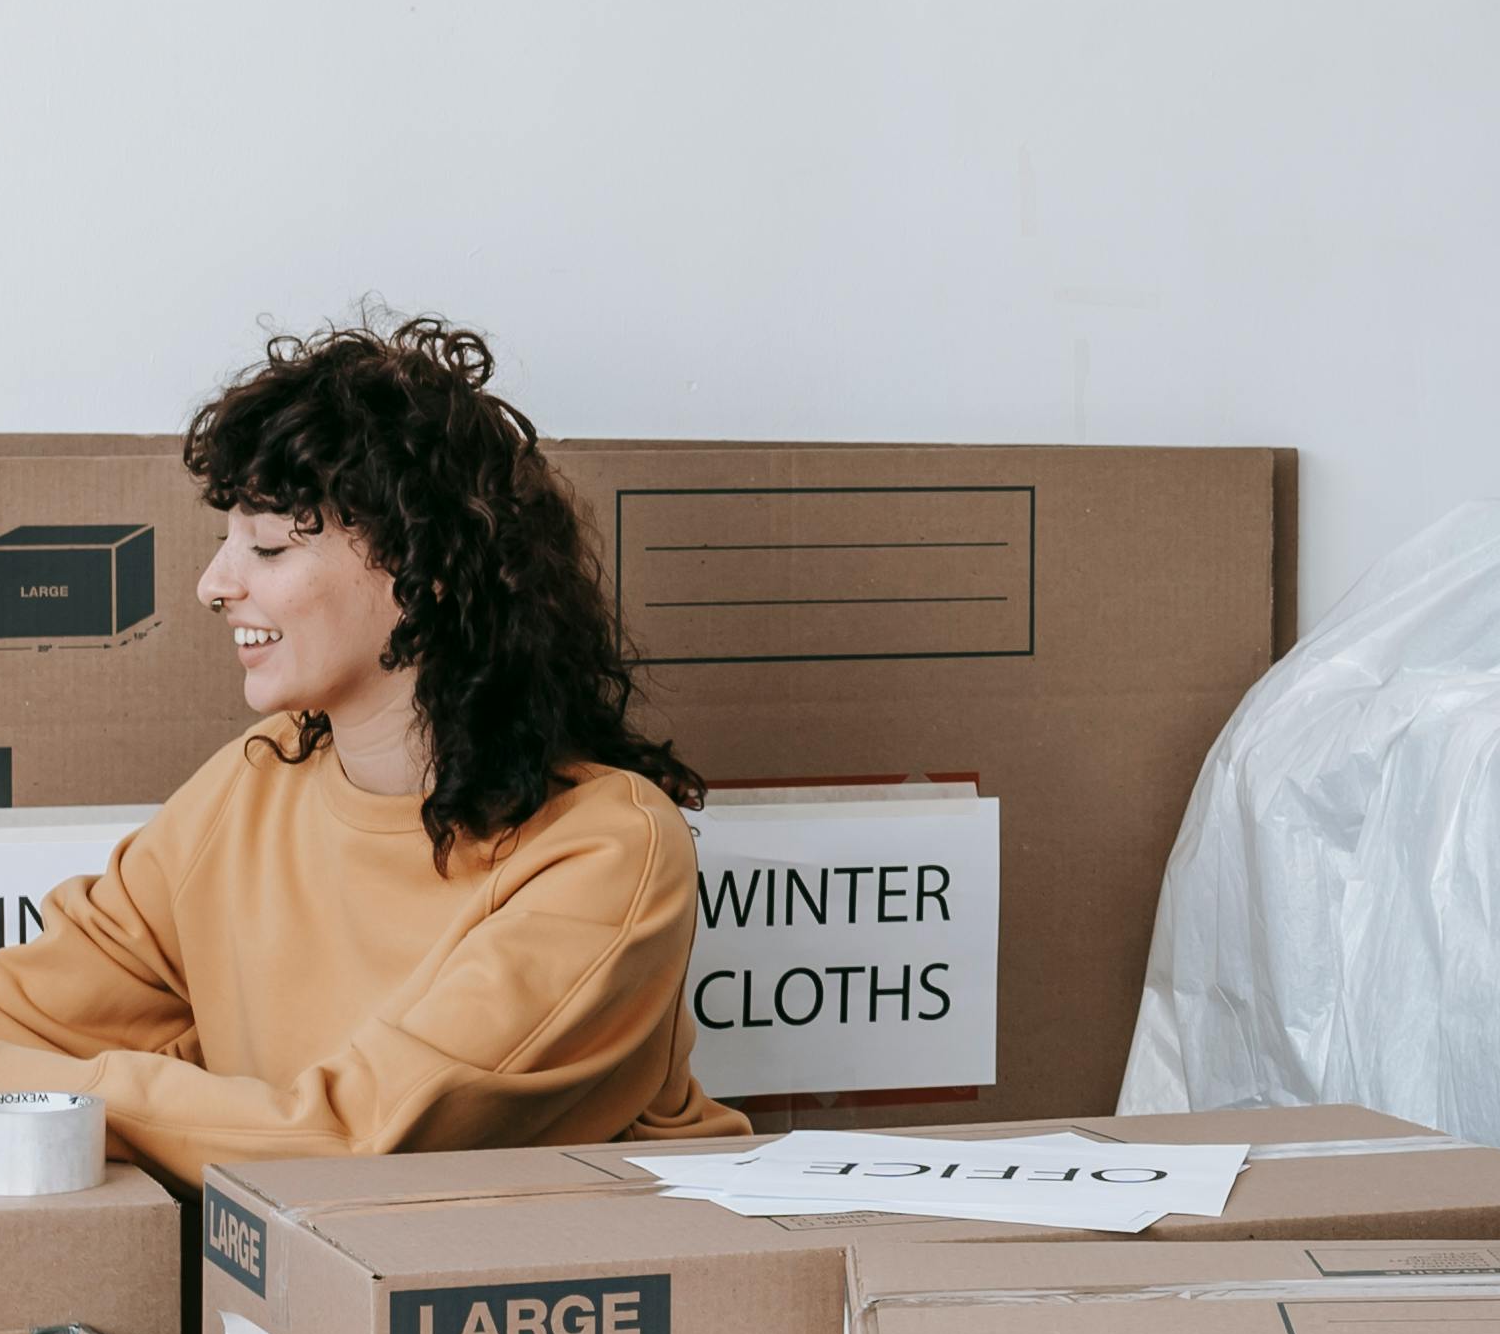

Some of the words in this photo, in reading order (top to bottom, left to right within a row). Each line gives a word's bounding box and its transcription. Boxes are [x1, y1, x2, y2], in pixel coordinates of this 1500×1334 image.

[20, 586, 69, 598] LARGE
[698, 865, 951, 928] WINTER
[693, 963, 951, 1029] CLOTHS
[803, 1162, 1168, 1183] OFFICE
[210, 1201, 260, 1279] LARGE
